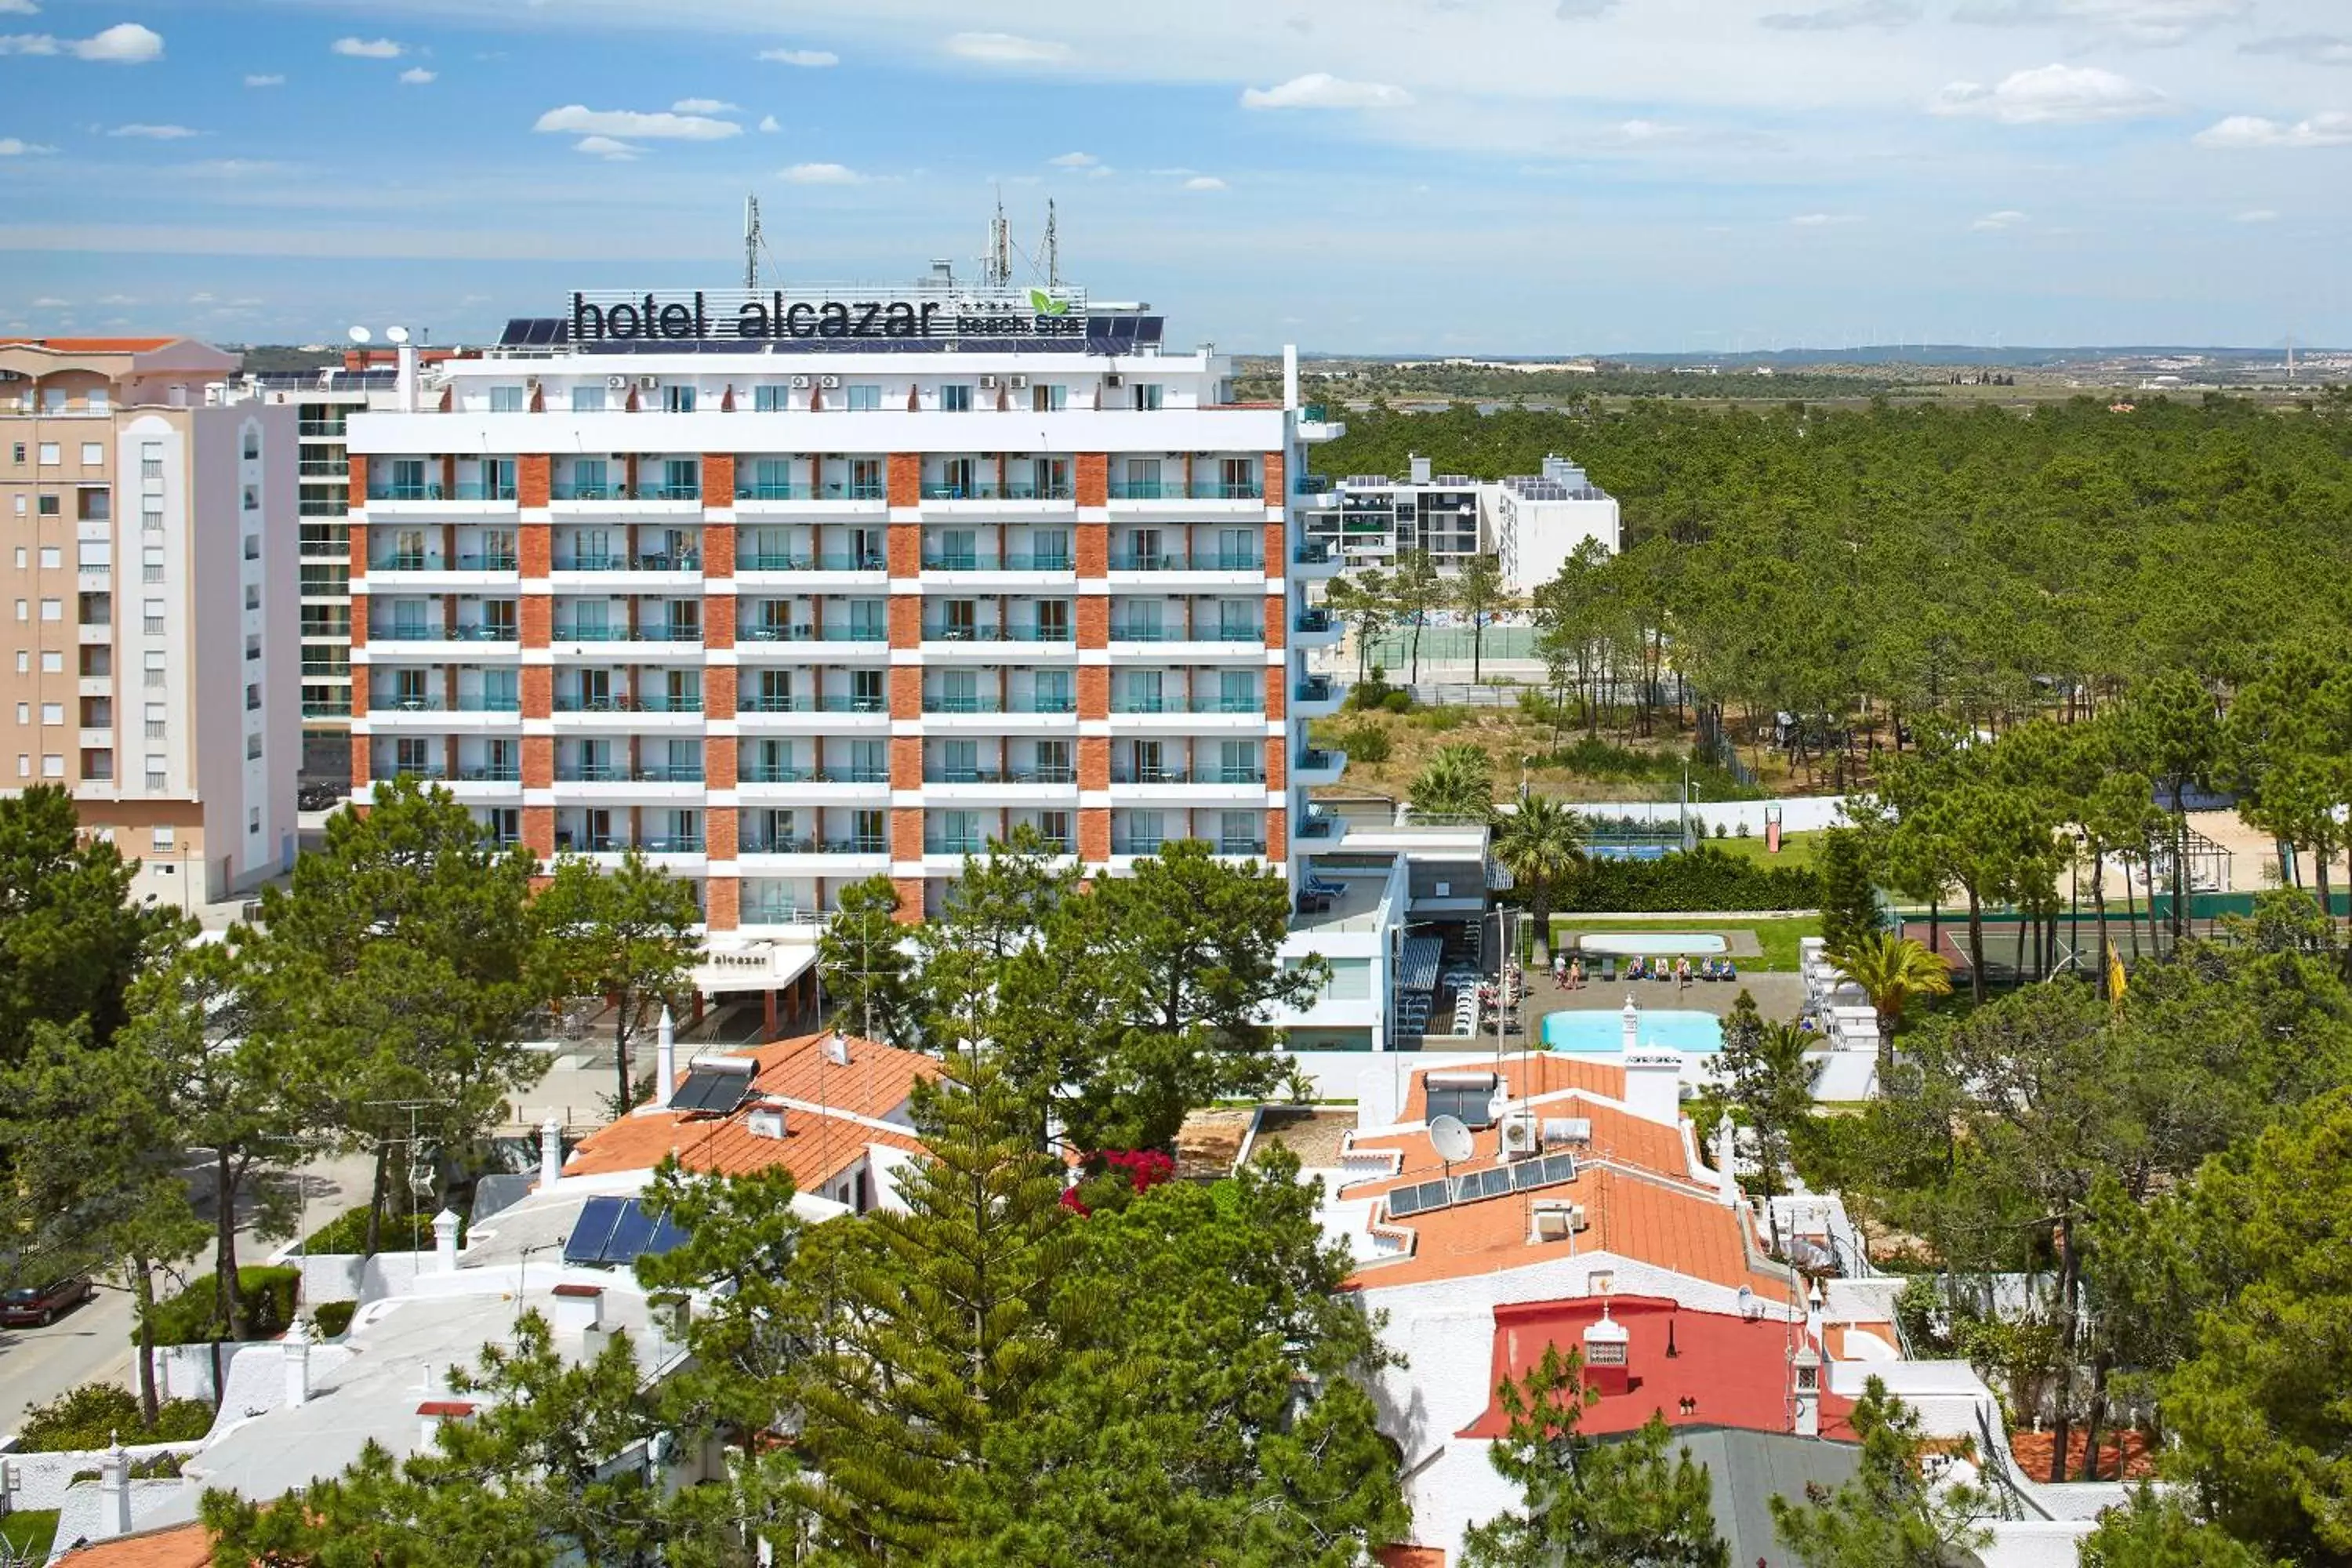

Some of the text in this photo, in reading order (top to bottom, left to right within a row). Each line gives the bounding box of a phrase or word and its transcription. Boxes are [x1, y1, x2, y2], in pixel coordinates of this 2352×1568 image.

[574, 291, 940, 339] hotel alcazar
[957, 315, 1026, 332] beach
[1034, 314, 1080, 337] Spa
